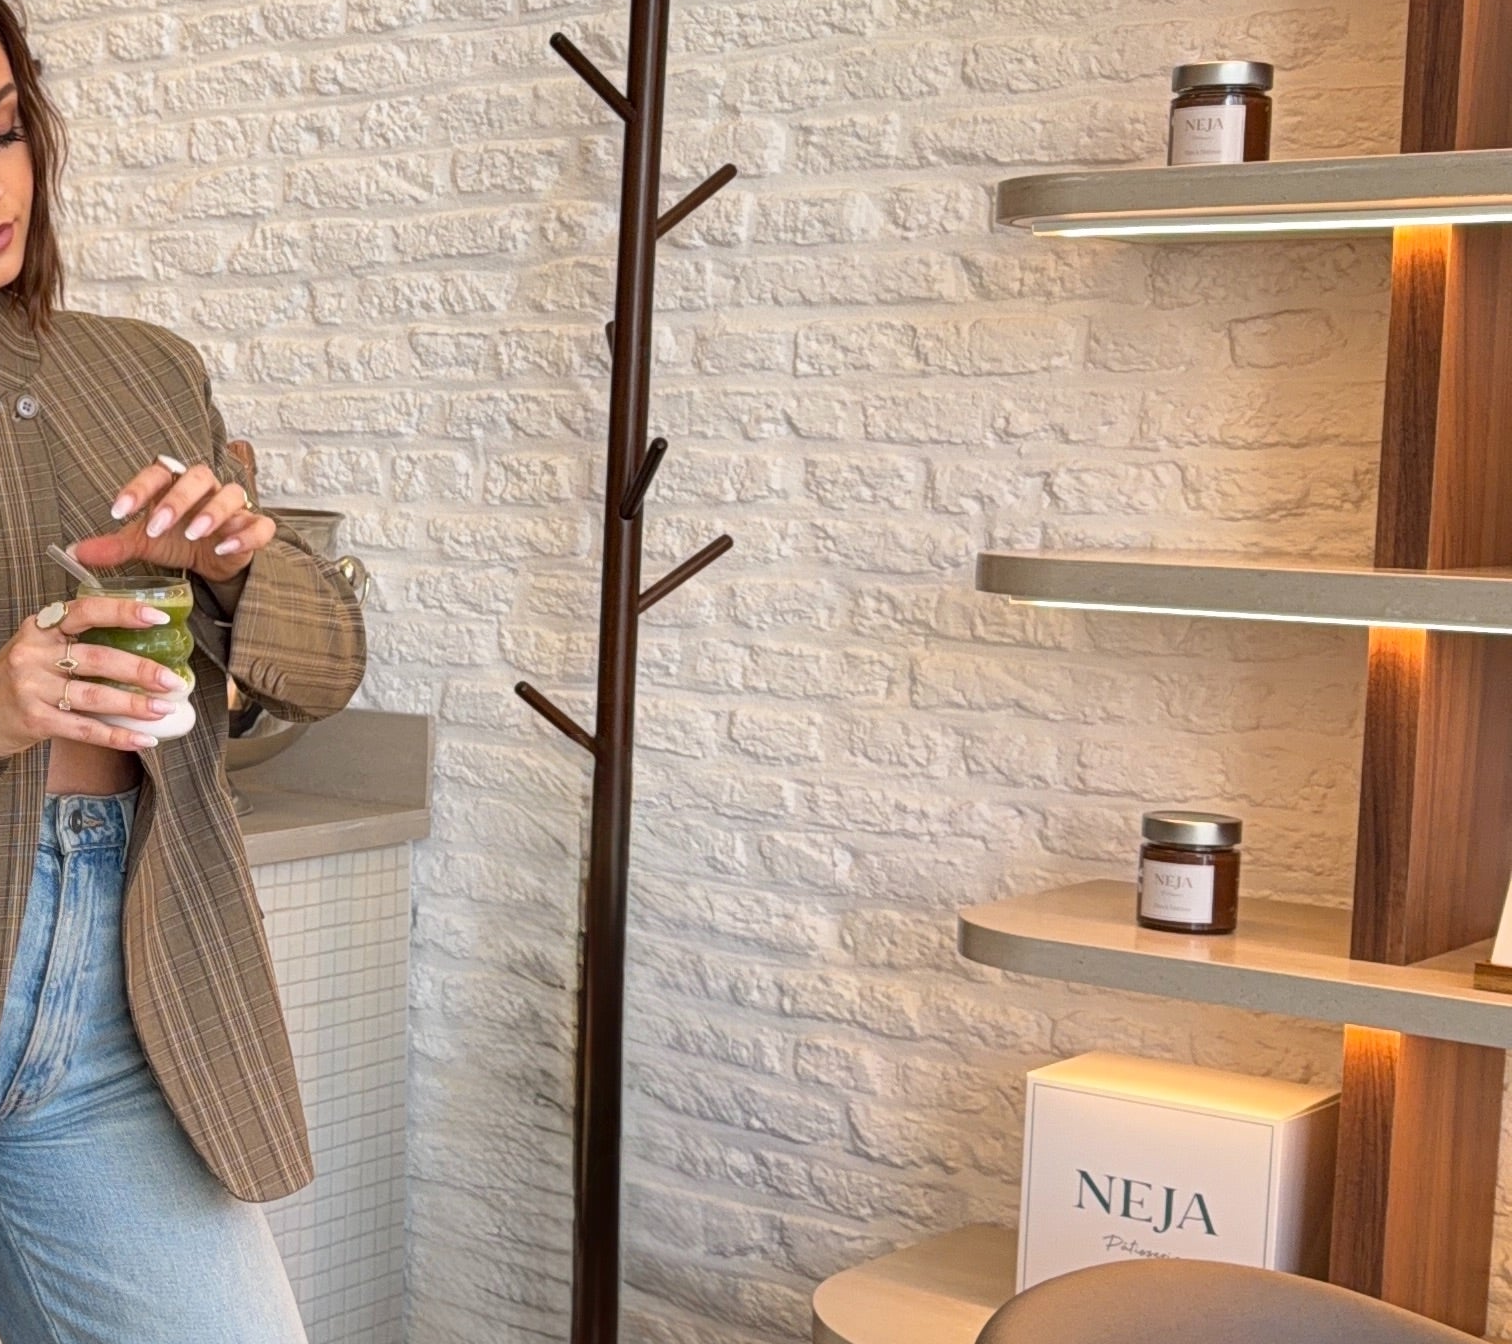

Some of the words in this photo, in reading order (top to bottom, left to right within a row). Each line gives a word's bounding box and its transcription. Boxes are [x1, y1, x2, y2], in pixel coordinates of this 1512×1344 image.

[1184, 118, 1225, 133] NEJA
[1154, 872, 1193, 890] NEJA
[1073, 1168, 1219, 1237] NEJA
